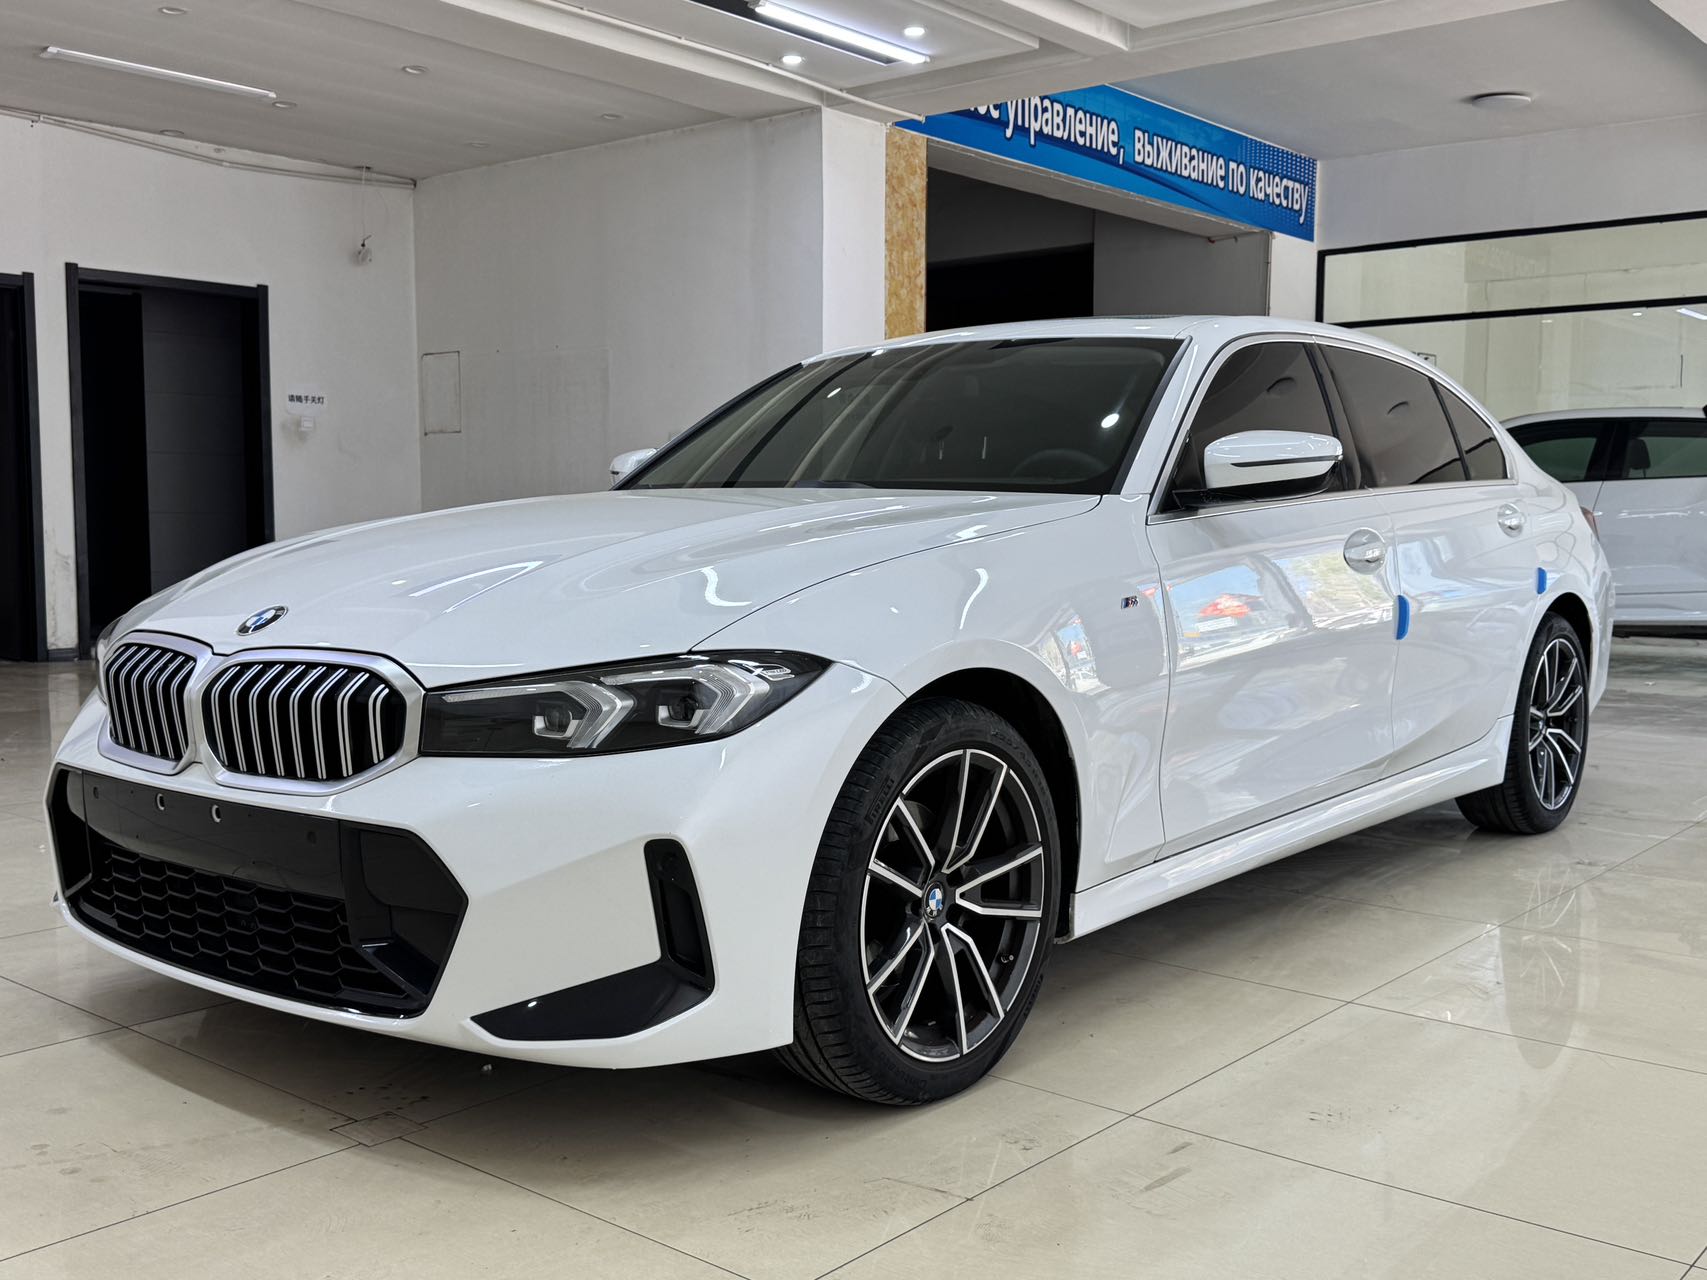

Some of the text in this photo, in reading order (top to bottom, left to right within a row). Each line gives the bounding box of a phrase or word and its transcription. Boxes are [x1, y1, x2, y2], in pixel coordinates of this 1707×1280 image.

[1005, 95, 1308, 224] управление, выживание по качеству
